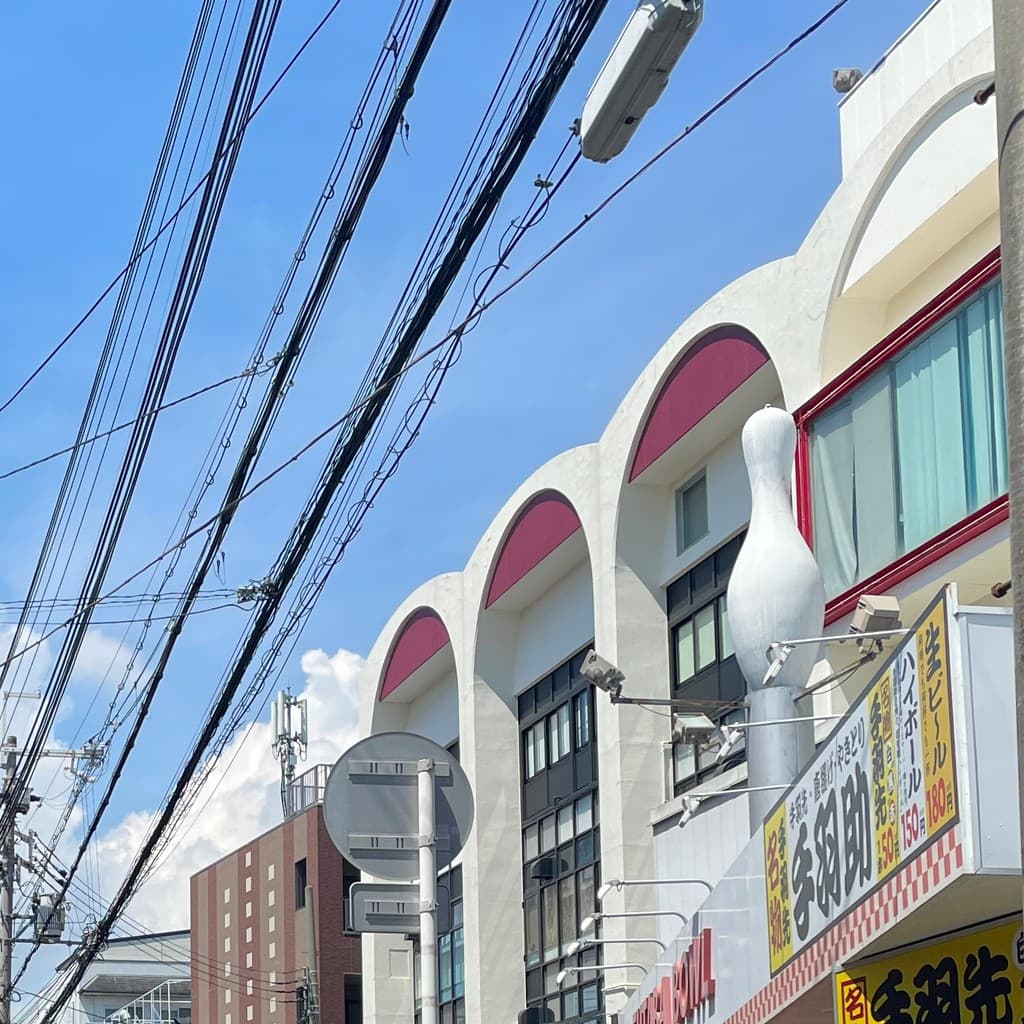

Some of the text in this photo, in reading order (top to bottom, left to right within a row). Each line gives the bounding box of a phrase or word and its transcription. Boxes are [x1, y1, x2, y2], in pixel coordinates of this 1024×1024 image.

[901, 651, 921, 799] ハイボール
[792, 762, 873, 941] 手羽助
